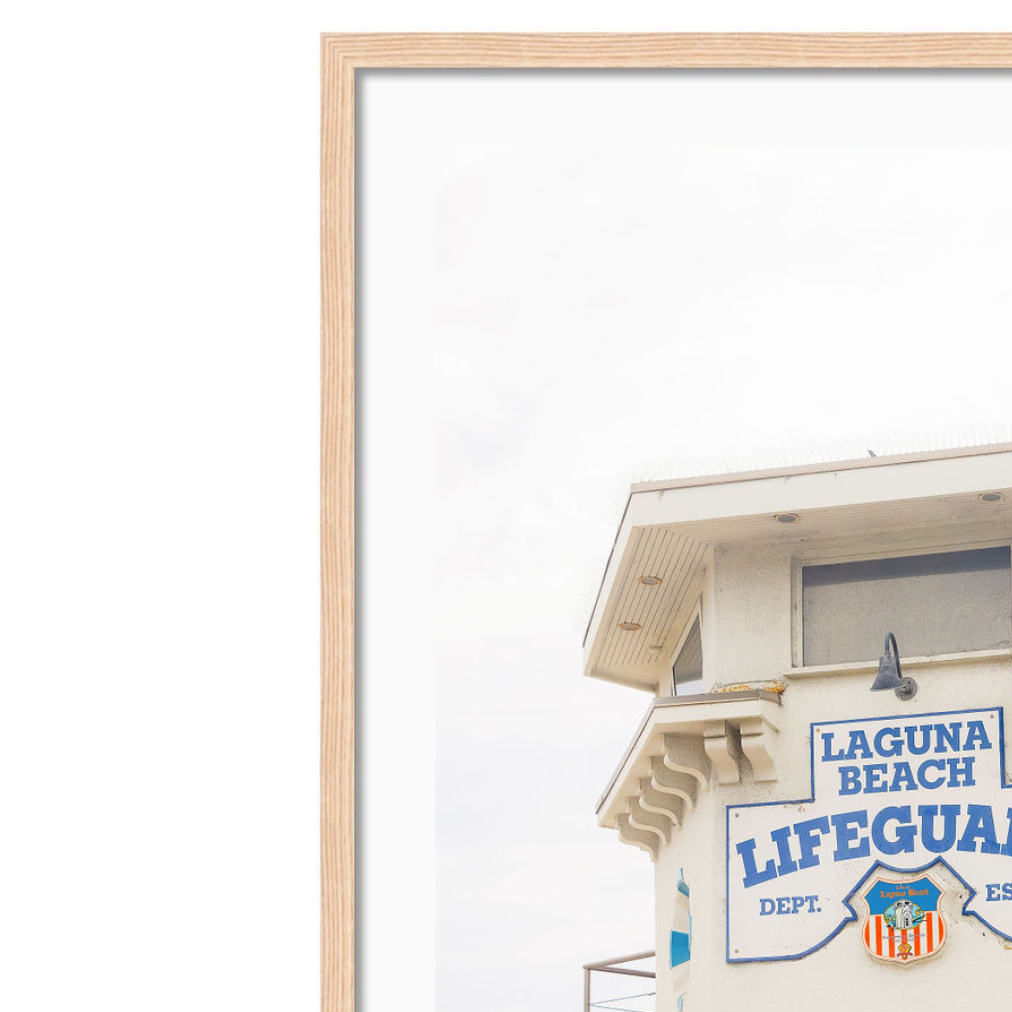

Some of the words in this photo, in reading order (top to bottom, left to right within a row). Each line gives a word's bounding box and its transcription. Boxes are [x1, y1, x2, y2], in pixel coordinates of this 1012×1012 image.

[821, 720, 992, 762] LAGUNA
[838, 756, 976, 796] BEACH
[759, 895, 823, 916] DEPT.
